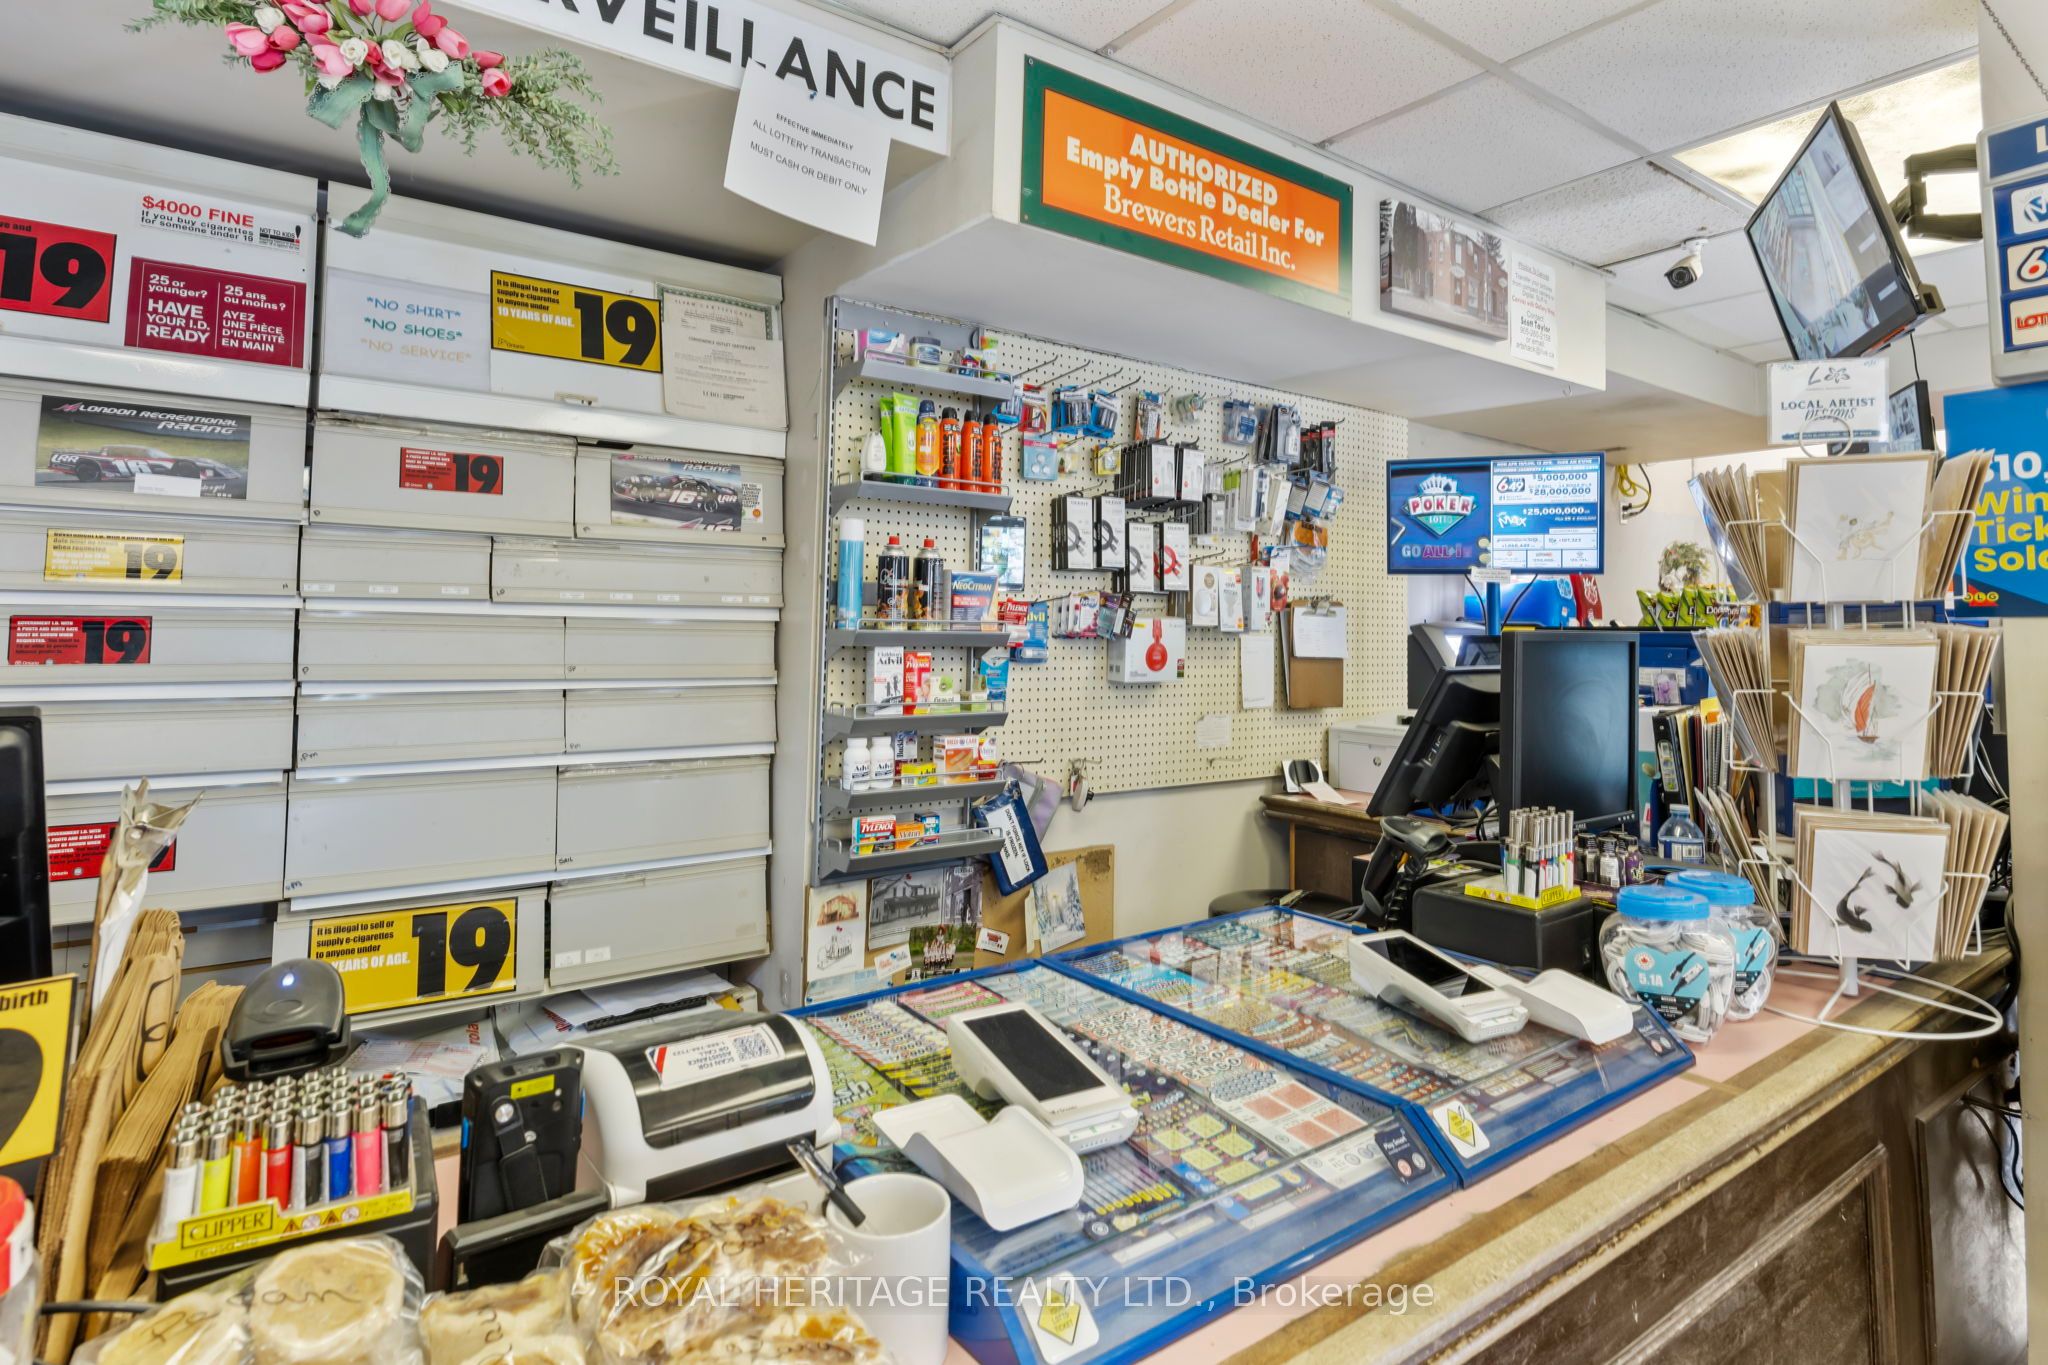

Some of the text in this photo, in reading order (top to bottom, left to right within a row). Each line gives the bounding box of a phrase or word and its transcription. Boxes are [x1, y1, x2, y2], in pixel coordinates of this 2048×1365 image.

[776, 112, 854, 151] EFFECTIVE IMMEDIATELY
[752, 119, 871, 176] ALL LOTTERY TRANSACTION
[750, 141, 868, 196] MUST CASH OR DEBIT ONLY
[1129, 132, 1278, 206] AUTHORIZED
[1066, 136, 1325, 247] Empty Bottle Dealer For
[142, 195, 255, 228] $4000 FINE
[12, 222, 32, 232] and
[141, 216, 254, 242] for someone under 19
[153, 212, 173, 222] you
[177, 216, 196, 226] buy
[200, 220, 254, 236] cigarettes
[259, 226, 272, 234] NOT
[1104, 182, 1296, 271] Brewers Retail Inc.
[0, 232, 107, 309] 19
[149, 273, 186, 288] 25 or
[510, 280, 531, 292] illegal
[148, 283, 208, 299] younger?
[224, 284, 267, 300] 25 ans
[497, 288, 560, 304] supply e-cigarettes
[223, 296, 239, 304] ou
[505, 298, 529, 308] anyone
[530, 302, 549, 311] under
[147, 298, 204, 320] HAVE
[222, 310, 256, 322] AYEZ
[510, 307, 540, 322] YEARS
[542, 312, 553, 324] OF
[146, 312, 211, 331] YOUR I.D.
[222, 320, 283, 334] UNE PIÈCE
[574, 290, 657, 366] 19
[1520, 316, 1550, 333] Scott Taylor
[146, 324, 210, 344] READY
[222, 328, 285, 344] D'IDENTITÉ
[222, 338, 275, 352] EN MAIN
[1781, 398, 1876, 411] LOCAL ARTIST
[452, 454, 500, 494] 19
[668, 490, 698, 504] 16
[1411, 498, 1470, 512] POKER
[1401, 545, 1421, 558] GO
[124, 543, 178, 578] 19
[82, 620, 147, 664] 19
[862, 823, 894, 833] TYLENOL
[1543, 890, 1562, 902] CLIPPER
[317, 920, 394, 936] It is illegal to sell or
[316, 931, 394, 947] supply e-cigarettes
[316, 944, 381, 959] to anyone under
[411, 906, 512, 998] 19
[331, 951, 410, 972] YEARS OF AGE.
[1638, 973, 1664, 987] 5.1A
[688, 1051, 732, 1066] ASSISTANCE
[715, 1058, 735, 1068] SCAN
[189, 1212, 266, 1241] CLIPPER
